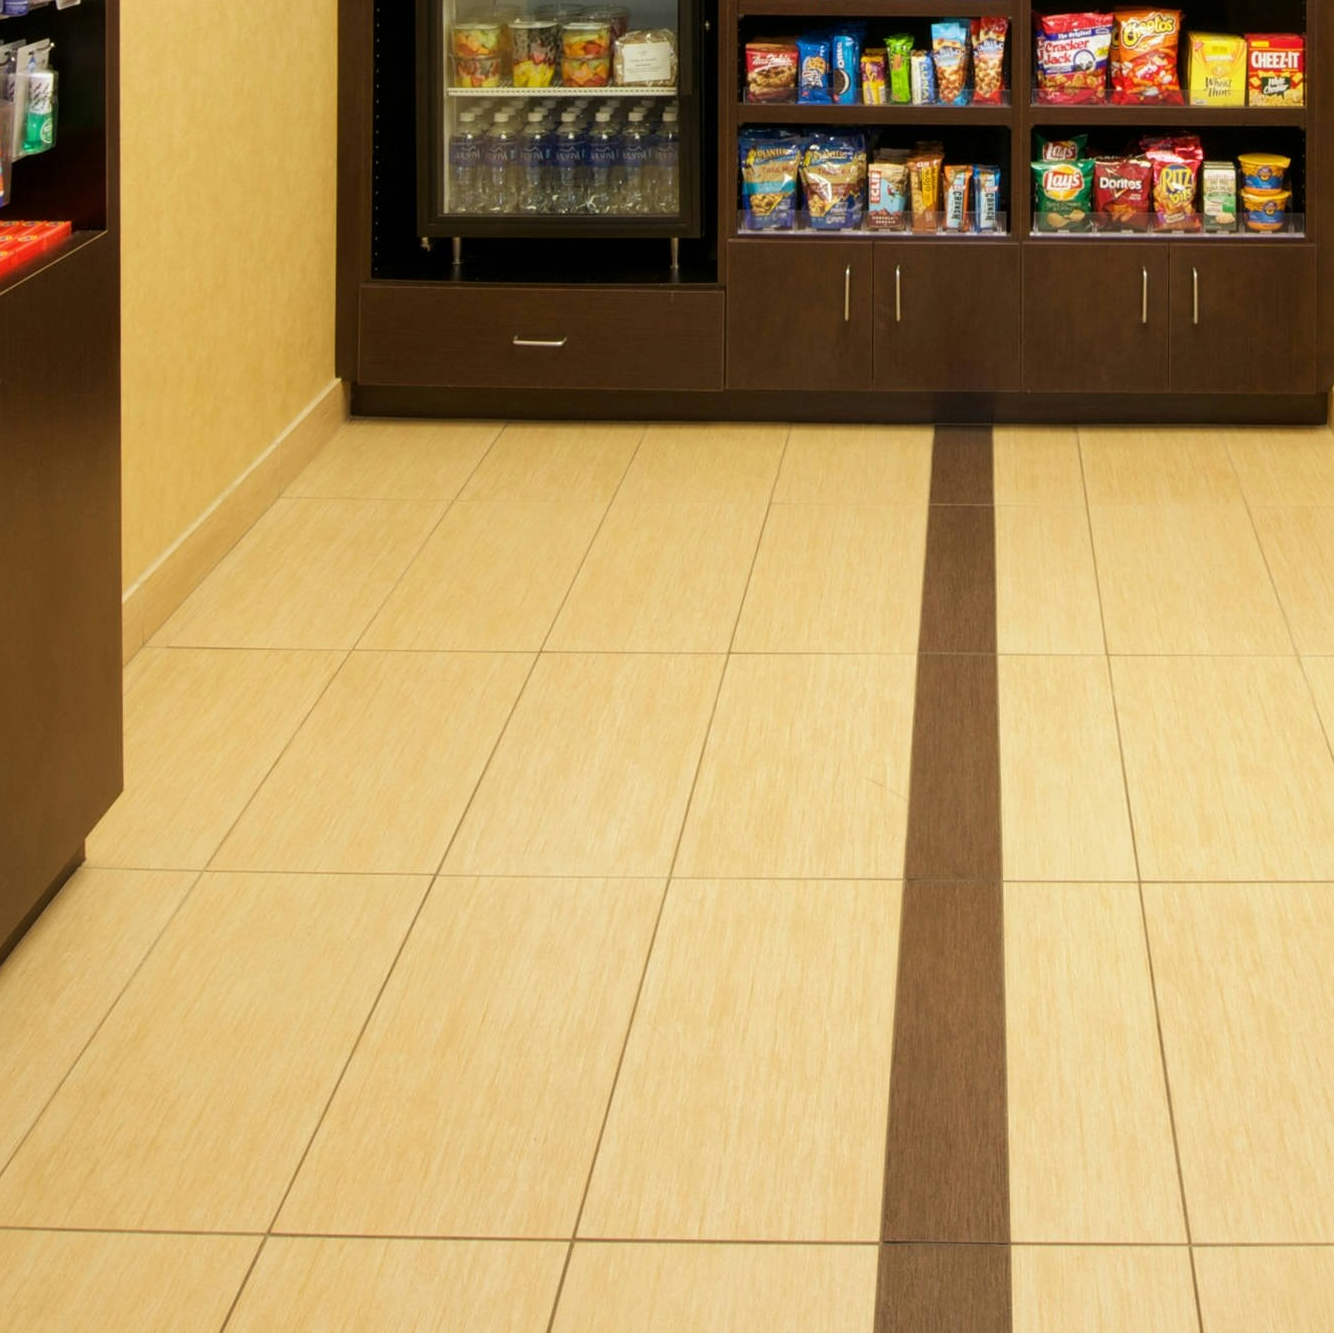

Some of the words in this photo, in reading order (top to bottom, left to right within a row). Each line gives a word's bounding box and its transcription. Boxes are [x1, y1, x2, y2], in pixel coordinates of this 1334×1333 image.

[1121, 15, 1174, 47] Cheetos
[1045, 39, 1089, 54] Cracker
[1043, 52, 1072, 66] Jack
[1251, 51, 1300, 68] CHEEZ-IT
[1046, 171, 1081, 189] Lay's
[1099, 178, 1142, 190] Doritos
[1161, 168, 1193, 191] RITZ
[953, 191, 962, 220] CRUNCH
[986, 193, 994, 221] CRUNCH
